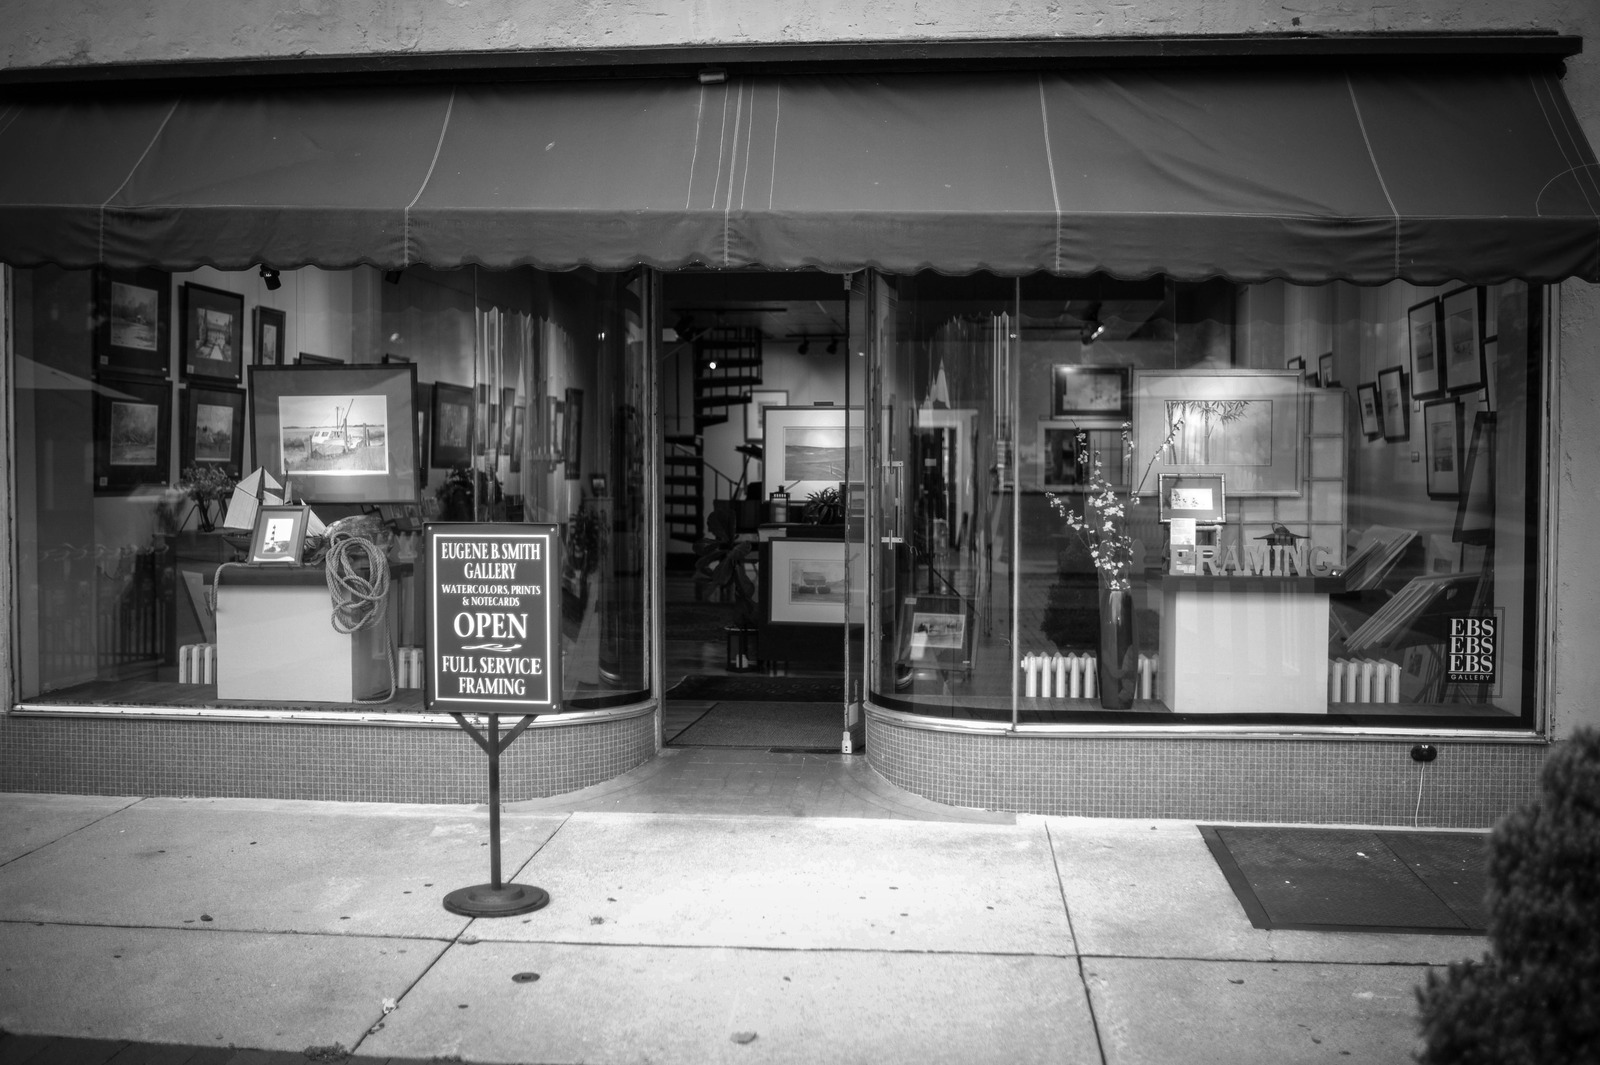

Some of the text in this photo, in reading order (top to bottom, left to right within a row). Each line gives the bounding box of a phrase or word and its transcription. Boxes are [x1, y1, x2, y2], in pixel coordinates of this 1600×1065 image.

[441, 542, 541, 560] EUGENE B. SMITH
[1169, 544, 1334, 577] FRAMING
[464, 562, 516, 579] GALLERY
[441, 584, 541, 595] WATERCOLORS, PRINTS
[462, 597, 520, 607] & NOTECARDS
[453, 612, 528, 639] OPEN
[1449, 618, 1494, 637] EBS
[1449, 636, 1493, 655] EBS
[442, 655, 542, 675] FULL SERVICE
[1449, 654, 1493, 672] EBS
[458, 677, 526, 696] FRAMING
